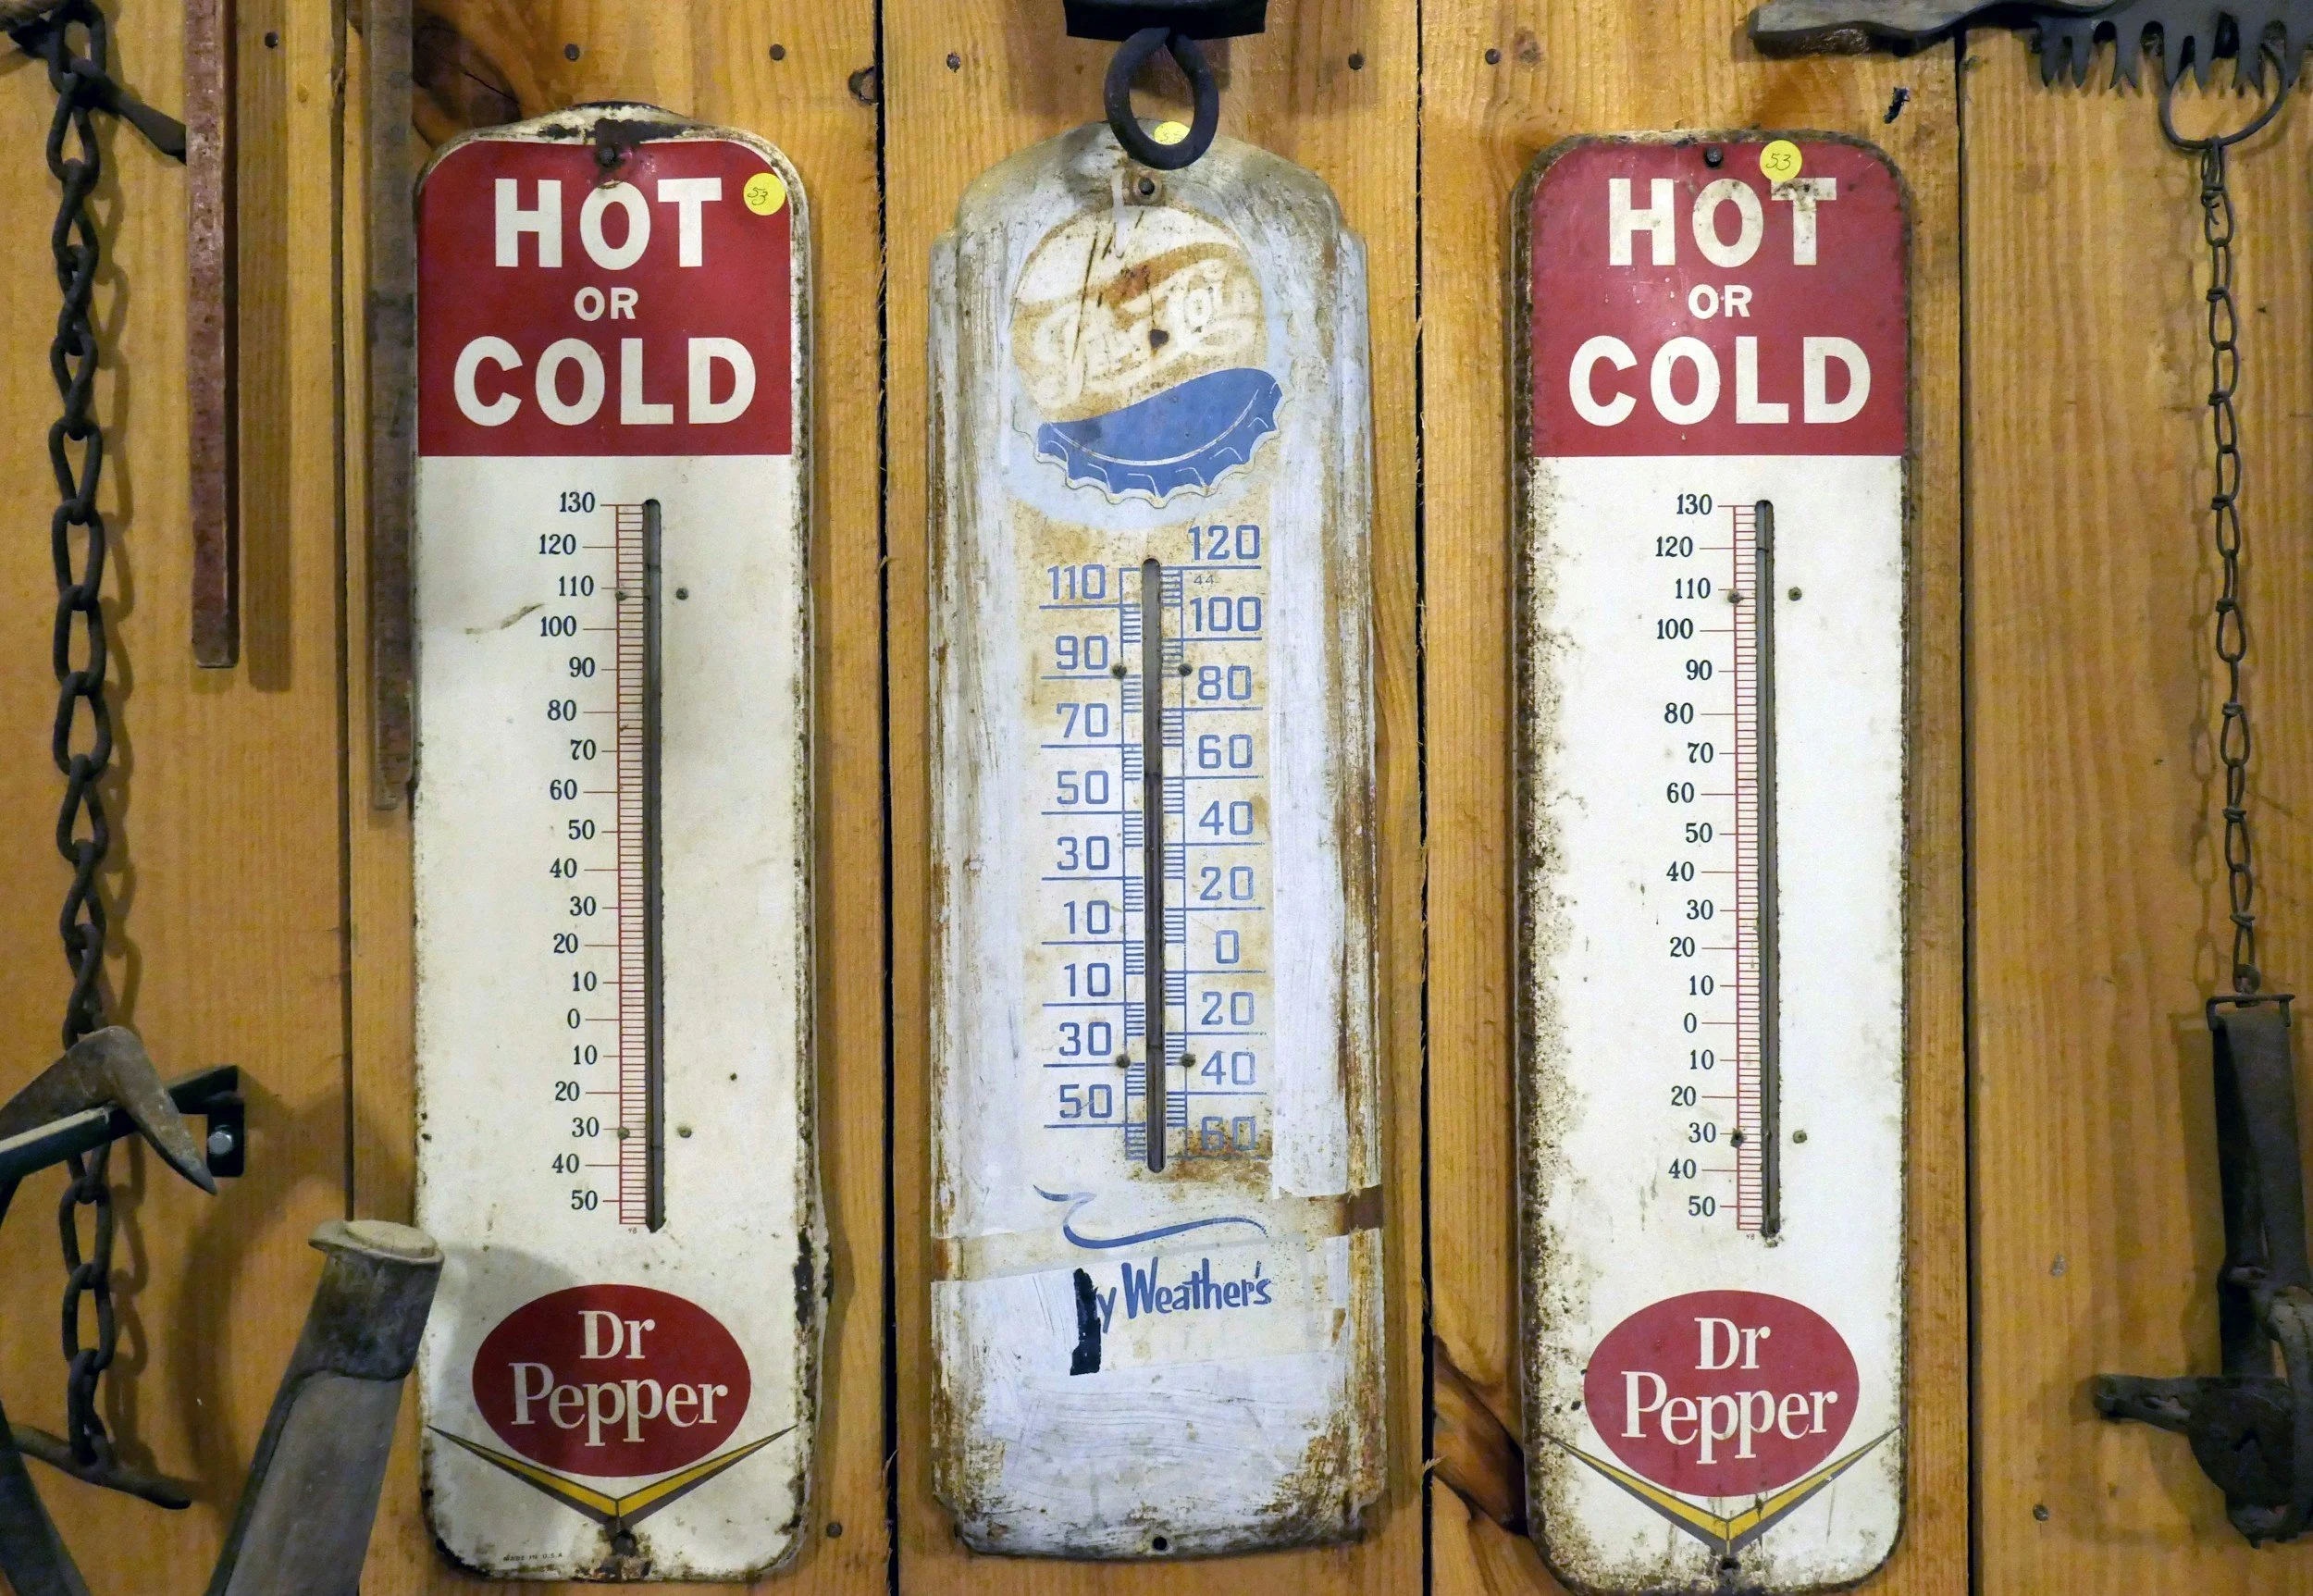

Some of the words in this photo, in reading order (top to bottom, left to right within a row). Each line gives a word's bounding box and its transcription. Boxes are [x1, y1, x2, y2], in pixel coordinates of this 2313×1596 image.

[1765, 153, 1791, 170] 53
[747, 187, 768, 205] 53
[495, 178, 722, 270] HOT
[1608, 178, 1837, 268] HOT
[574, 286, 639, 321] OR
[1688, 284, 1753, 319] OR
[453, 336, 756, 427] COLD
[1568, 335, 1871, 427] COLD
[560, 492, 595, 513] 130
[1676, 494, 1713, 515] 130
[538, 534, 576, 555] 120
[1188, 525, 1260, 561] 120
[1655, 536, 1693, 557] 120
[559, 575, 594, 597] 110
[1047, 564, 1106, 600] 110
[1676, 577, 1711, 599] 110
[1190, 597, 1261, 632] 100
[540, 615, 576, 637] 100
[1657, 618, 1693, 639] 100
[1055, 636, 1107, 670] 90
[569, 656, 595, 677] 90
[1686, 659, 1713, 681] 90
[1198, 665, 1252, 700] 80
[547, 699, 576, 721] 80
[1057, 703, 1108, 737] 70
[1664, 702, 1693, 724] 80
[570, 739, 597, 761] 70
[1198, 735, 1253, 769] 60
[1688, 742, 1713, 763] 70
[550, 779, 577, 800] 60
[1057, 771, 1108, 805] 50
[1666, 782, 1695, 803] 60
[1199, 800, 1253, 835] 40
[568, 819, 595, 840] 50
[1686, 823, 1713, 843] 50
[1057, 835, 1109, 871] 30
[550, 858, 577, 878] 40
[1666, 860, 1695, 882] 40
[1200, 866, 1253, 901] 20
[570, 896, 597, 916] 30
[1064, 900, 1109, 934] 10
[1687, 899, 1713, 920] 30
[553, 933, 578, 954] 20
[1216, 930, 1239, 963] 0
[1670, 936, 1695, 958] 20
[573, 971, 597, 992] 10
[1064, 962, 1110, 996] 10
[1689, 975, 1714, 996] 10
[567, 1008, 580, 1029] 0
[1201, 991, 1254, 1025] 20
[1683, 1012, 1697, 1033] 0
[1058, 1022, 1111, 1056] 30
[574, 1045, 598, 1065] 10
[1690, 1049, 1714, 1070] 10
[1201, 1050, 1255, 1085] 40
[555, 1081, 580, 1102] 20
[1059, 1084, 1112, 1119] 50
[1671, 1085, 1697, 1107] 20
[572, 1117, 600, 1137] 30
[1202, 1116, 1255, 1150] 60
[1688, 1122, 1716, 1143] 30
[551, 1153, 580, 1173] 40
[1668, 1158, 1697, 1179] 40
[571, 1190, 598, 1211] 50
[1688, 1195, 1715, 1217] 50
[1121, 1256, 1271, 1319] Weather's
[578, 1310, 656, 1359] Dr
[1694, 1317, 1771, 1369] Dr
[508, 1362, 728, 1447] Pepper
[1621, 1370, 1838, 1465] Pepper
